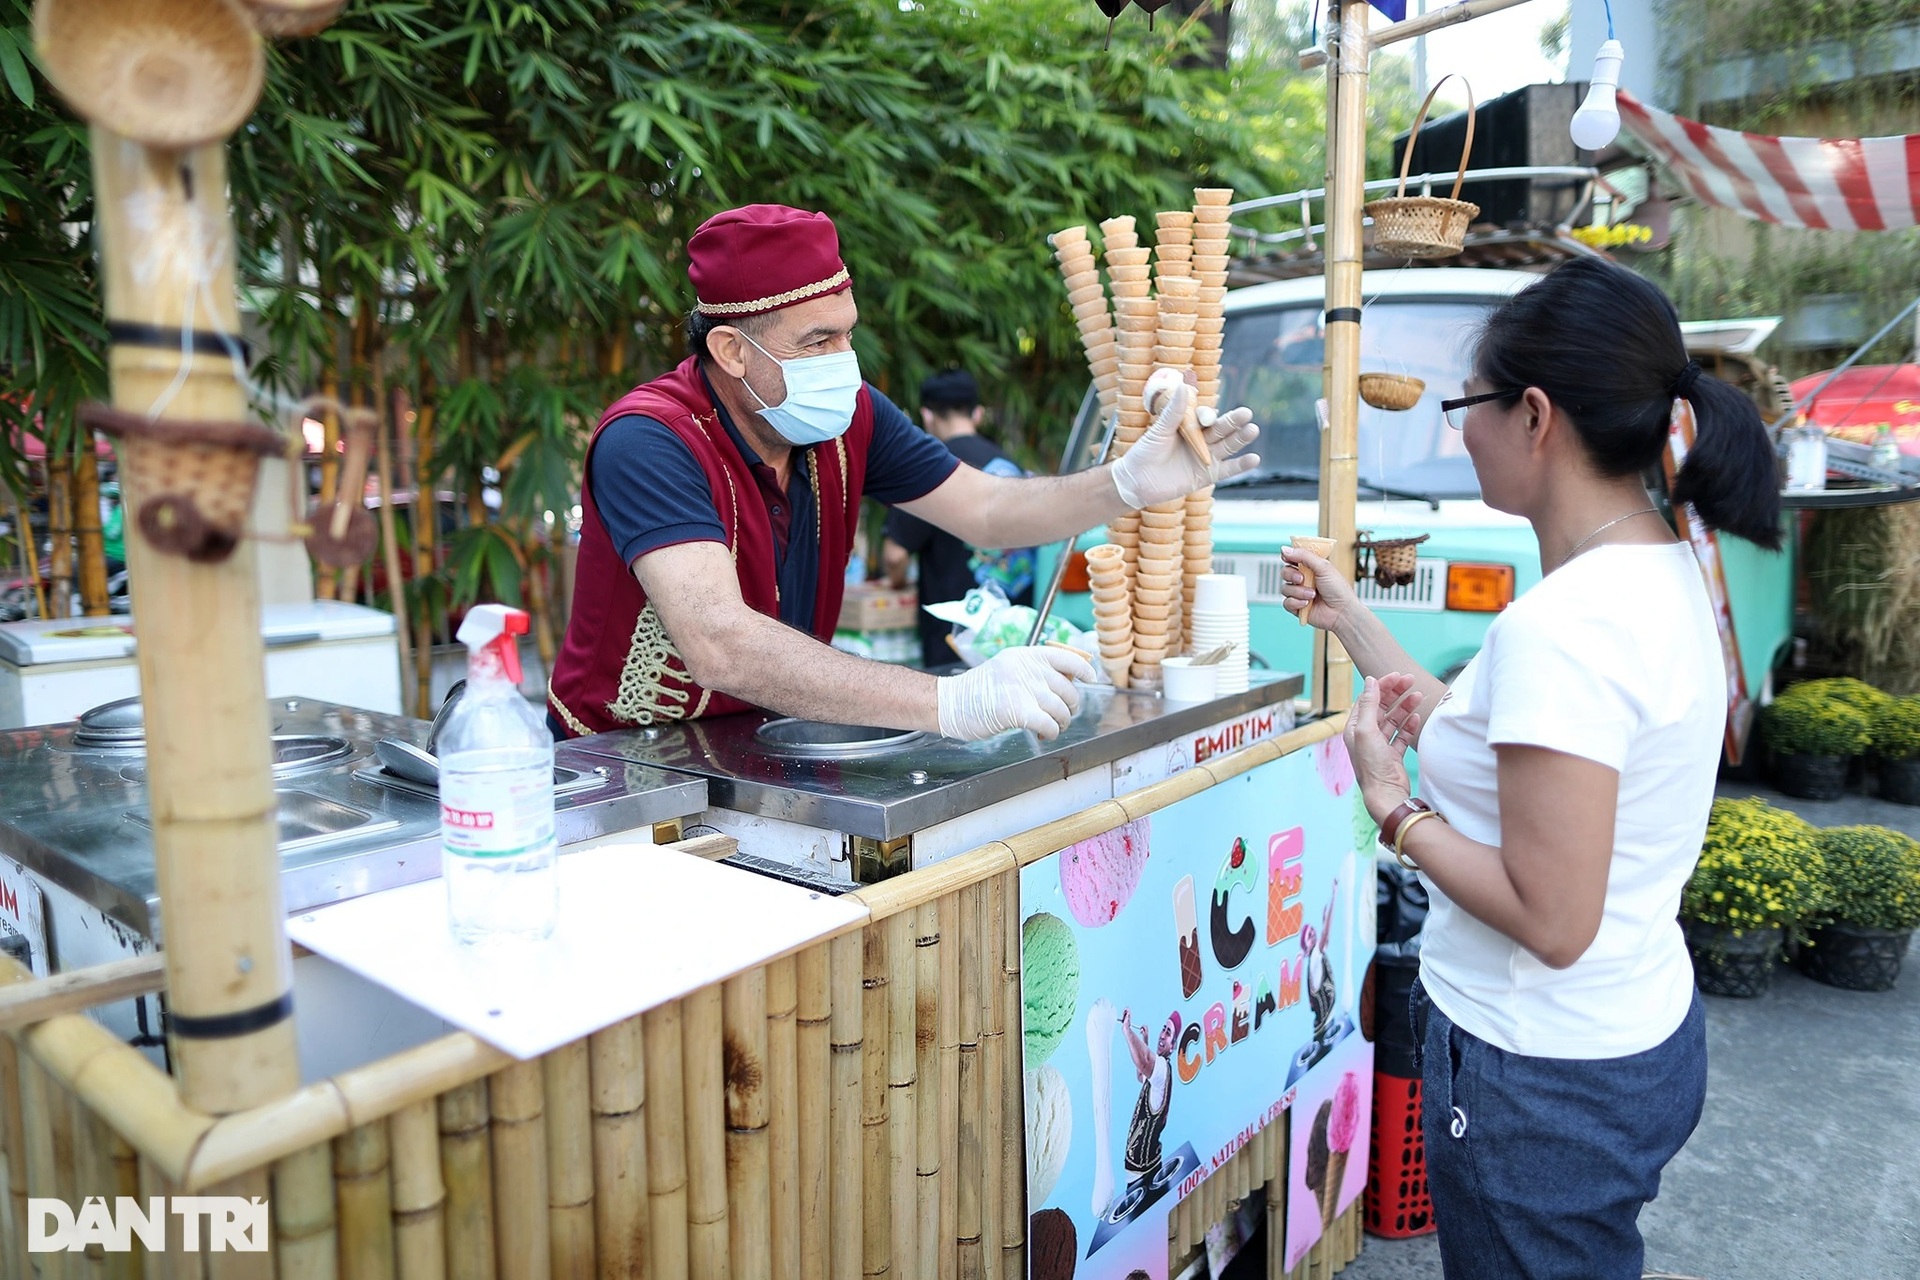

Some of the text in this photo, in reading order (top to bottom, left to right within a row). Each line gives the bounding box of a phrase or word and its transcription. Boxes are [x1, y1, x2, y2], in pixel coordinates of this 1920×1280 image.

[1172, 824, 1304, 1001] ICE
[1177, 952, 1303, 1084] CREAM
[1177, 1163, 1209, 1200] 100%
[1212, 1123, 1255, 1169] NATURAL
